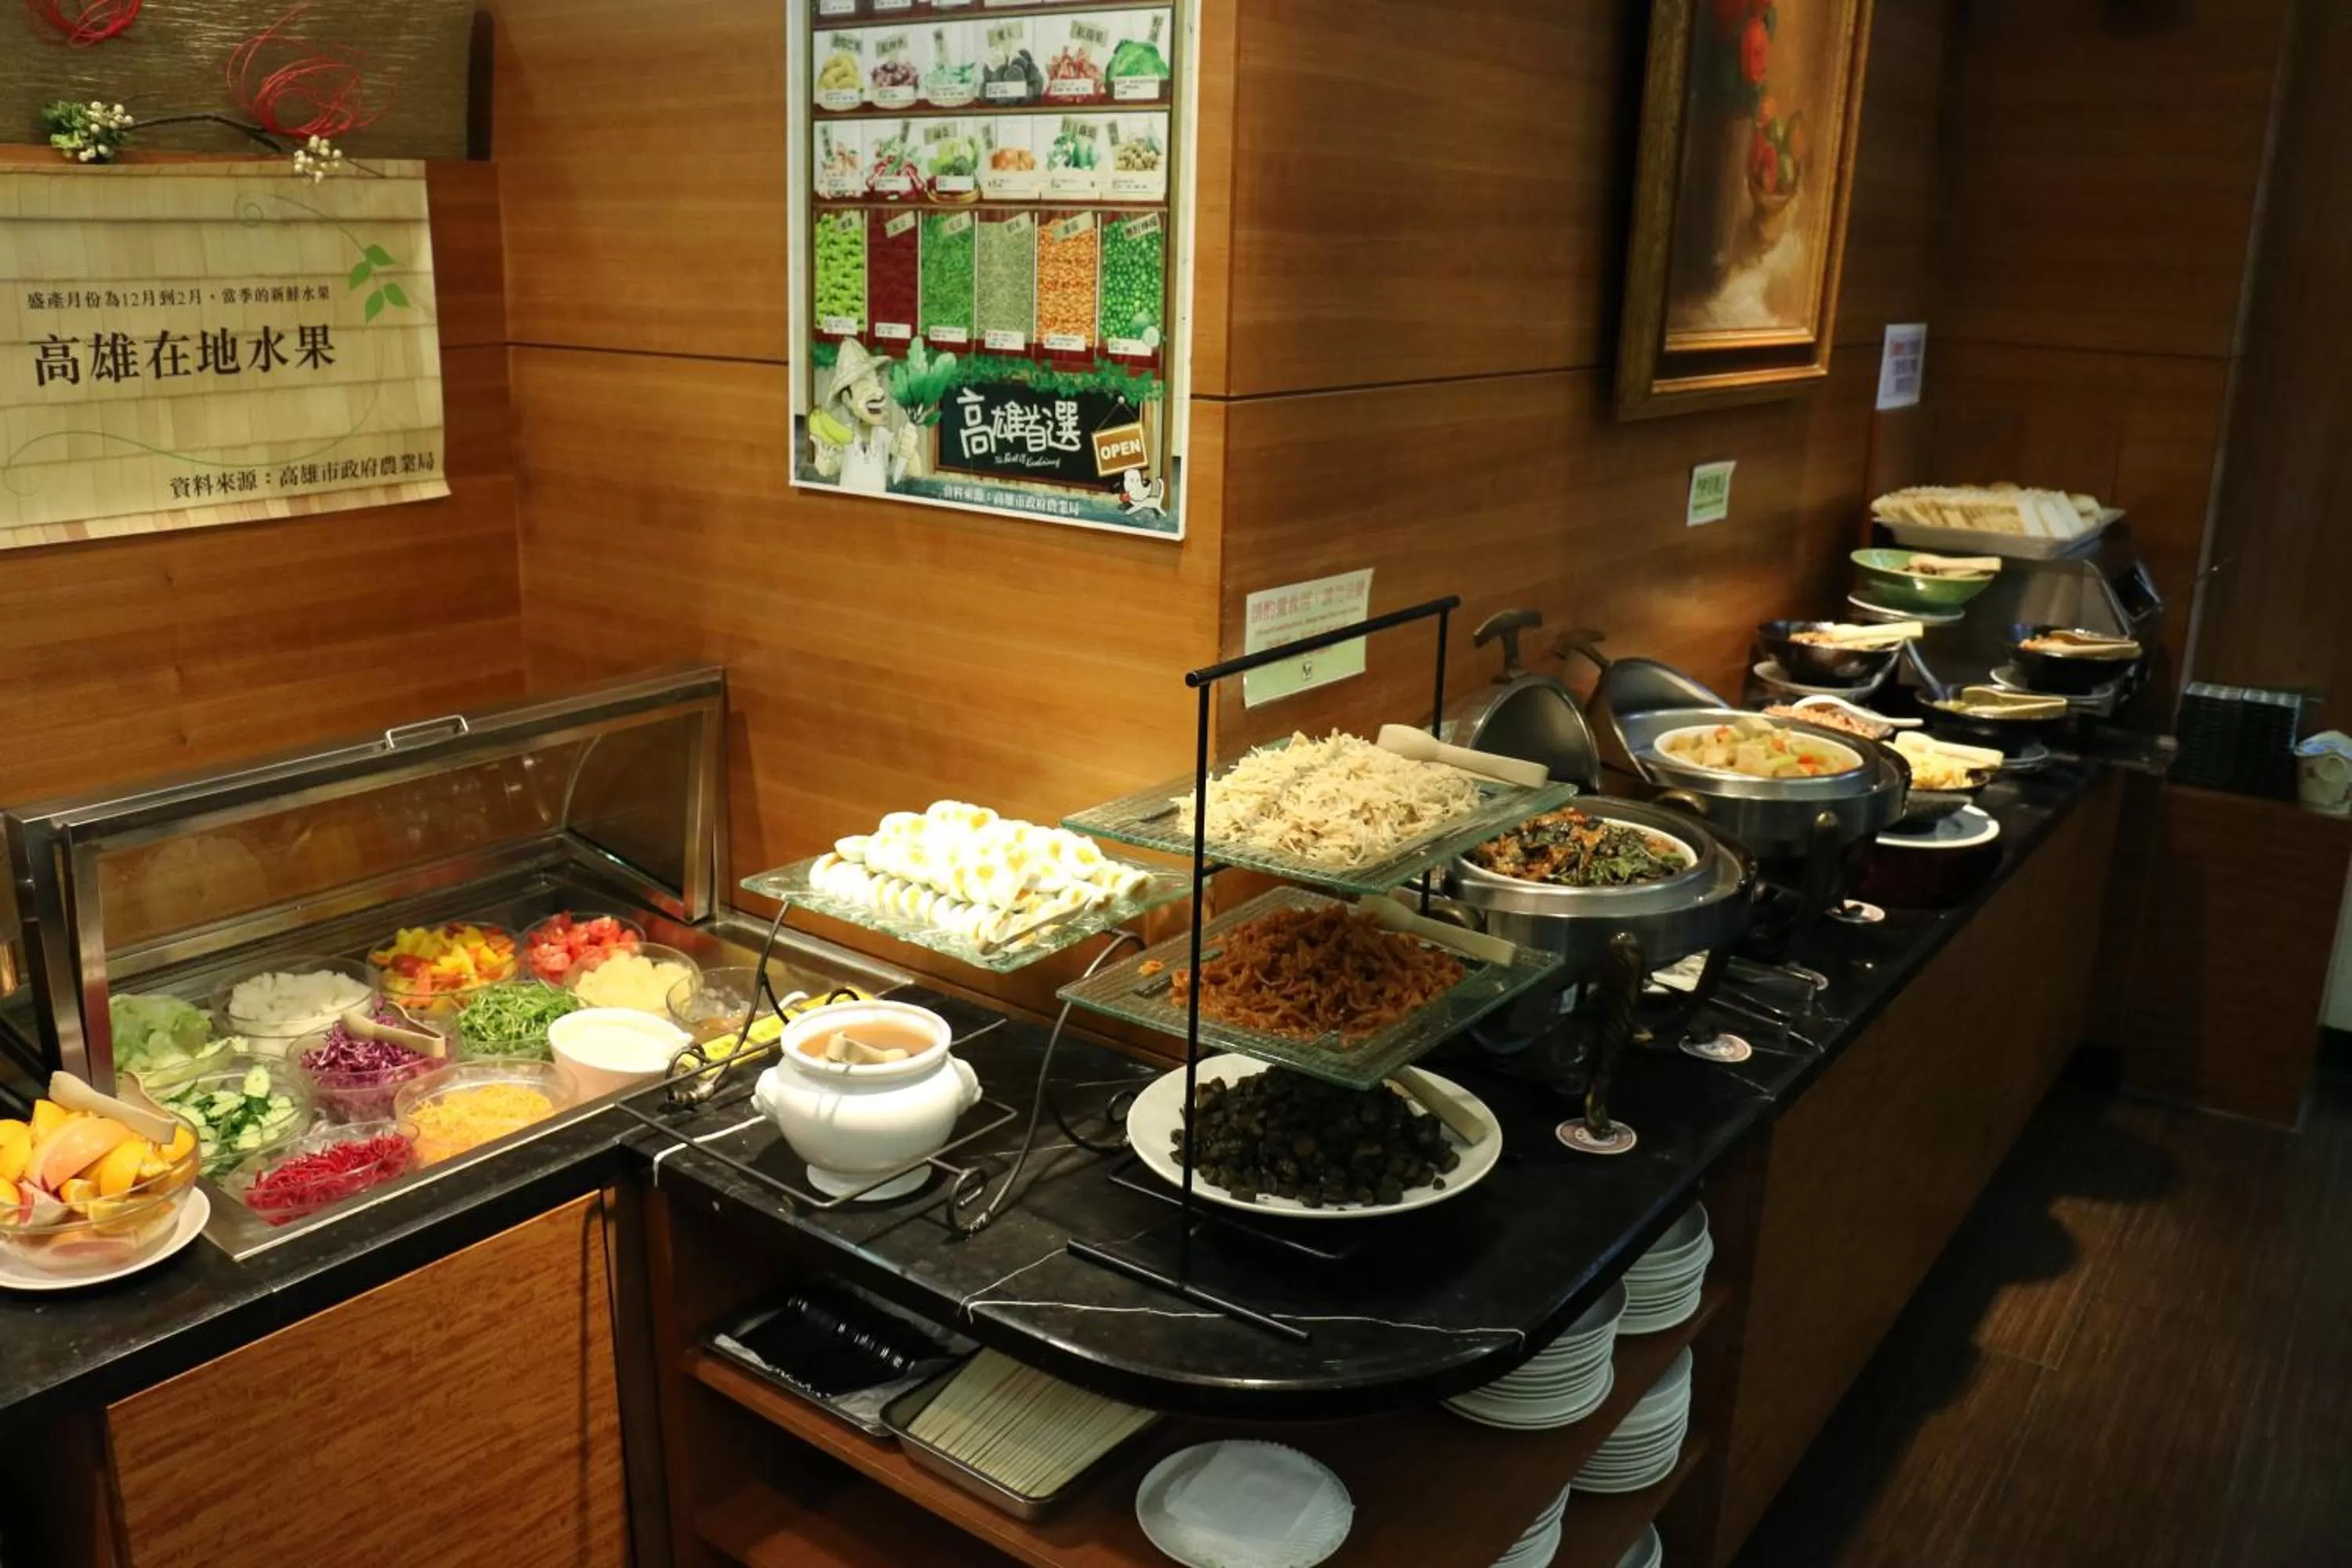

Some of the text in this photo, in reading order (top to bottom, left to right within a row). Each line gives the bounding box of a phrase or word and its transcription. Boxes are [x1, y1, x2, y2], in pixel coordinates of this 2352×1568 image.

[28, 324, 336, 387] 高雄在地水果
[956, 387, 1081, 459] 高雄首選
[1101, 438, 1142, 460] OPEN
